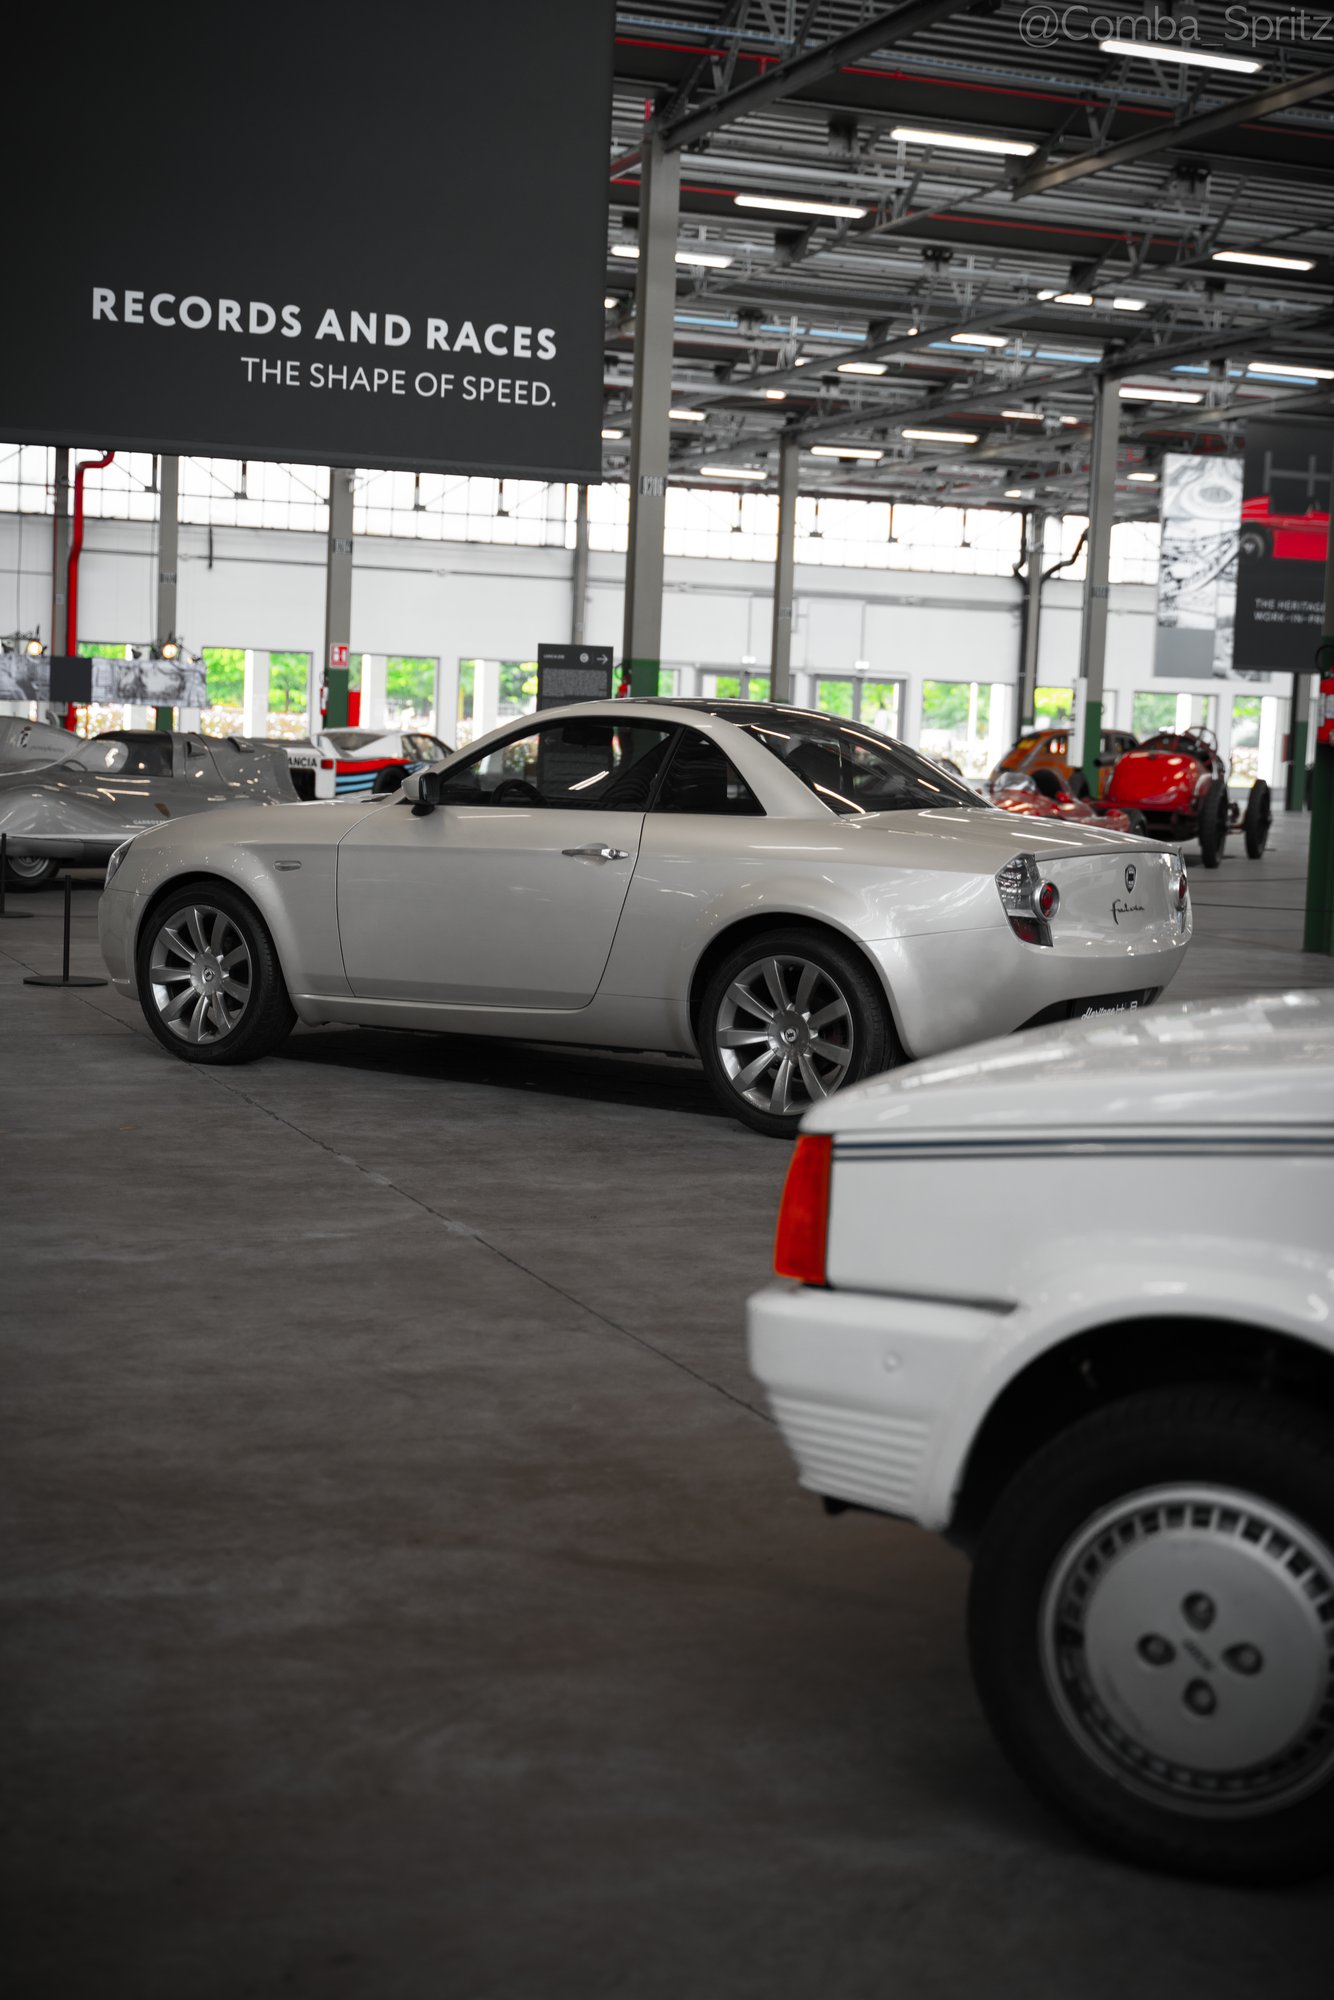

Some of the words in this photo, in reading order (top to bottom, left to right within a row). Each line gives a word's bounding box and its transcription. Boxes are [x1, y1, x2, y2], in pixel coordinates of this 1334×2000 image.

[92, 287, 302, 338] RECORDS
[314, 308, 411, 347] AND
[426, 317, 557, 360] RACES
[240, 356, 301, 386] THE
[309, 362, 406, 395] SHAPE
[414, 372, 455, 398] OF
[462, 375, 557, 407] SPEED.
[1254, 597, 1275, 609] THE
[287, 756, 317, 767] ANCIA
